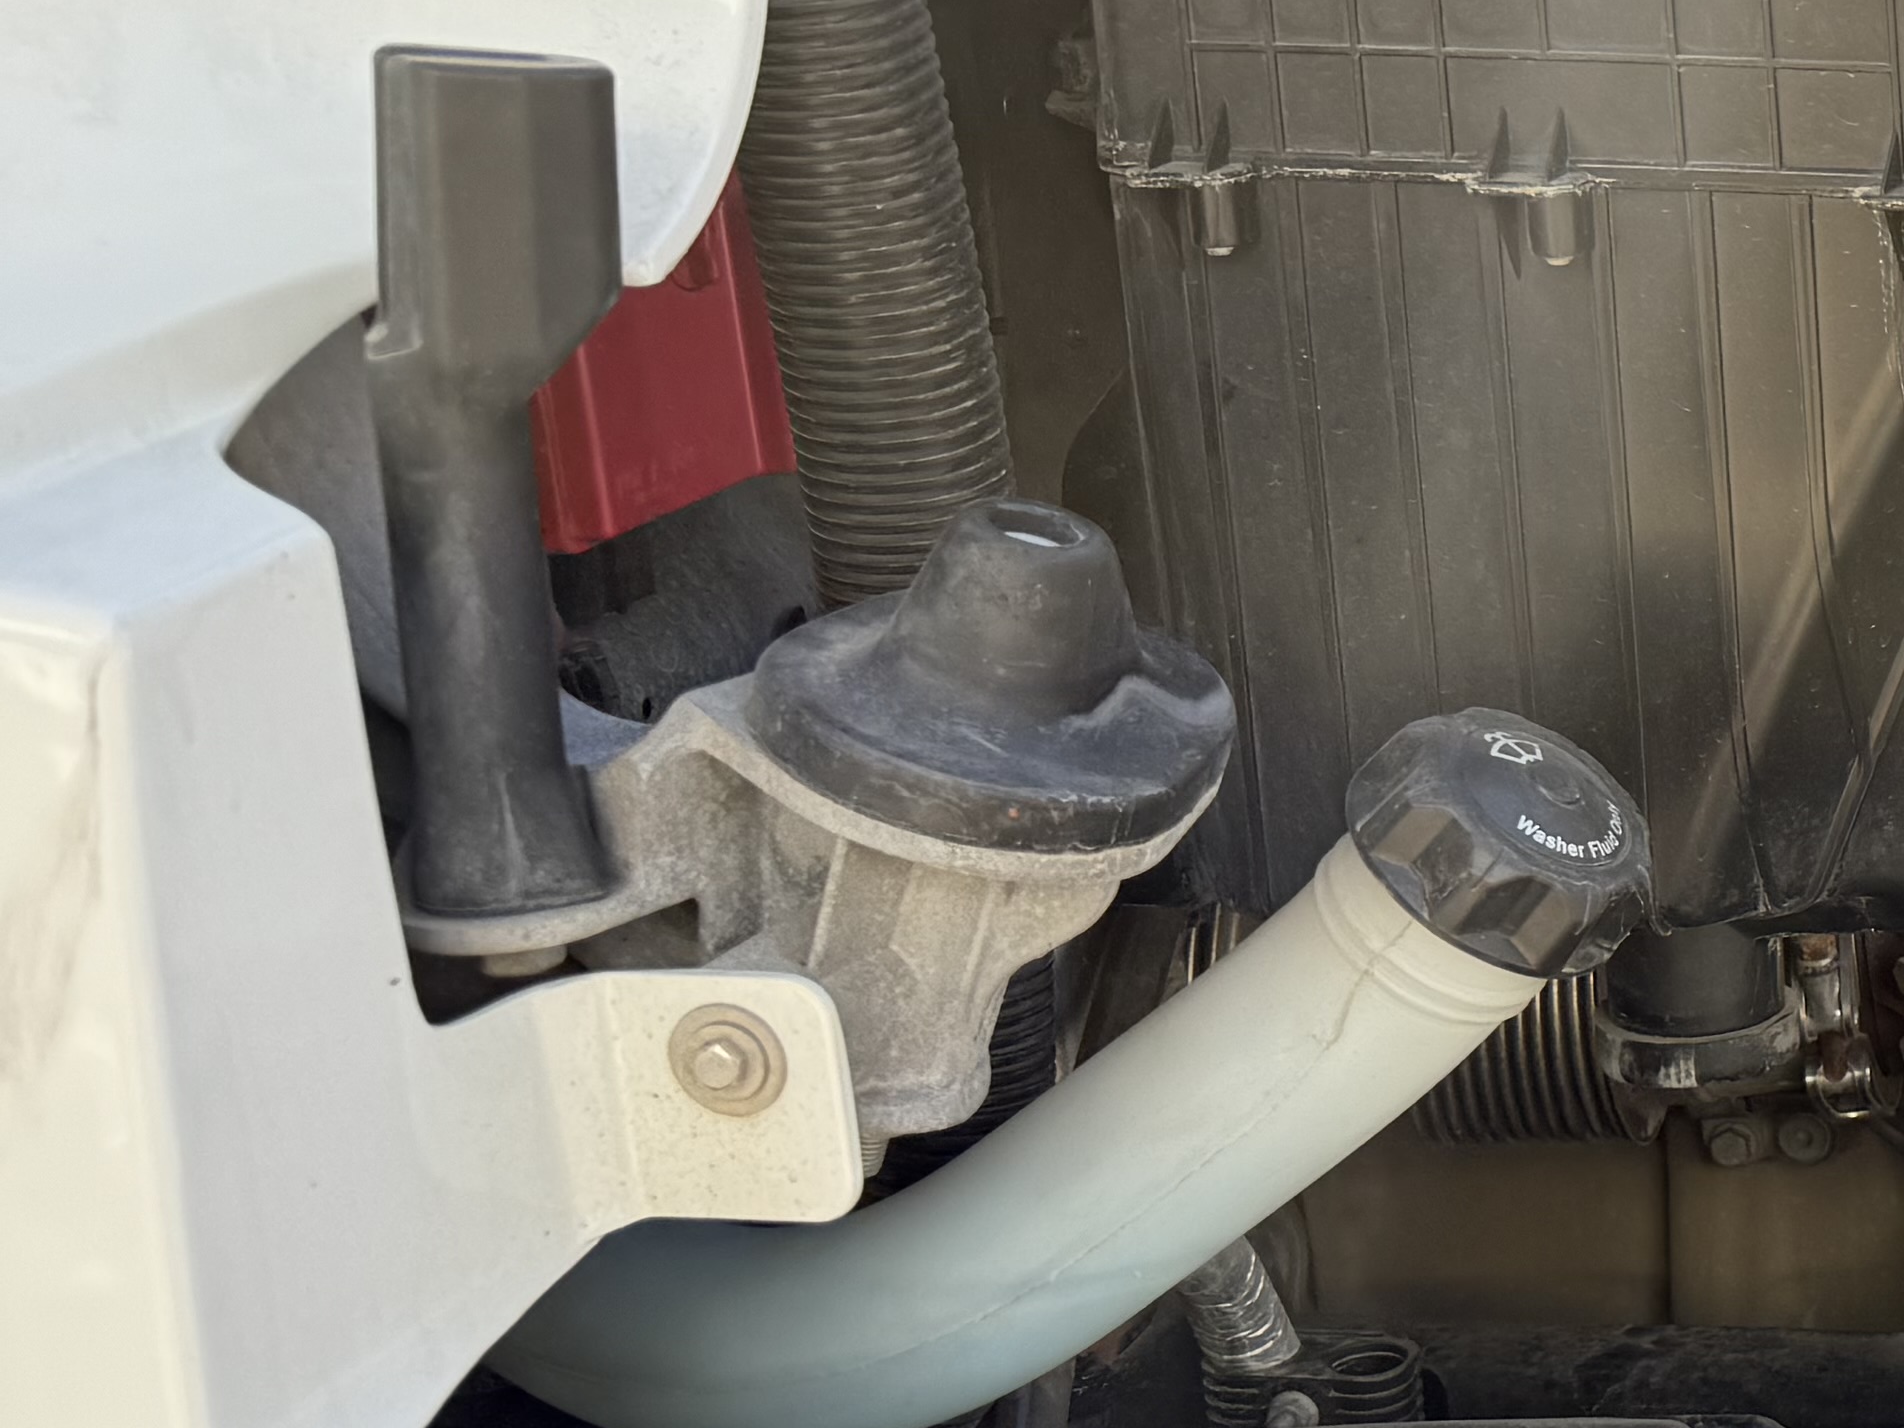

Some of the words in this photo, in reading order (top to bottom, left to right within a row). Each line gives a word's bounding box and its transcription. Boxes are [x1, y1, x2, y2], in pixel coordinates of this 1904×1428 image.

[1516, 814, 1585, 858] Washer
[1587, 829, 1620, 859] Fluid
[1606, 798, 1623, 836] Only
